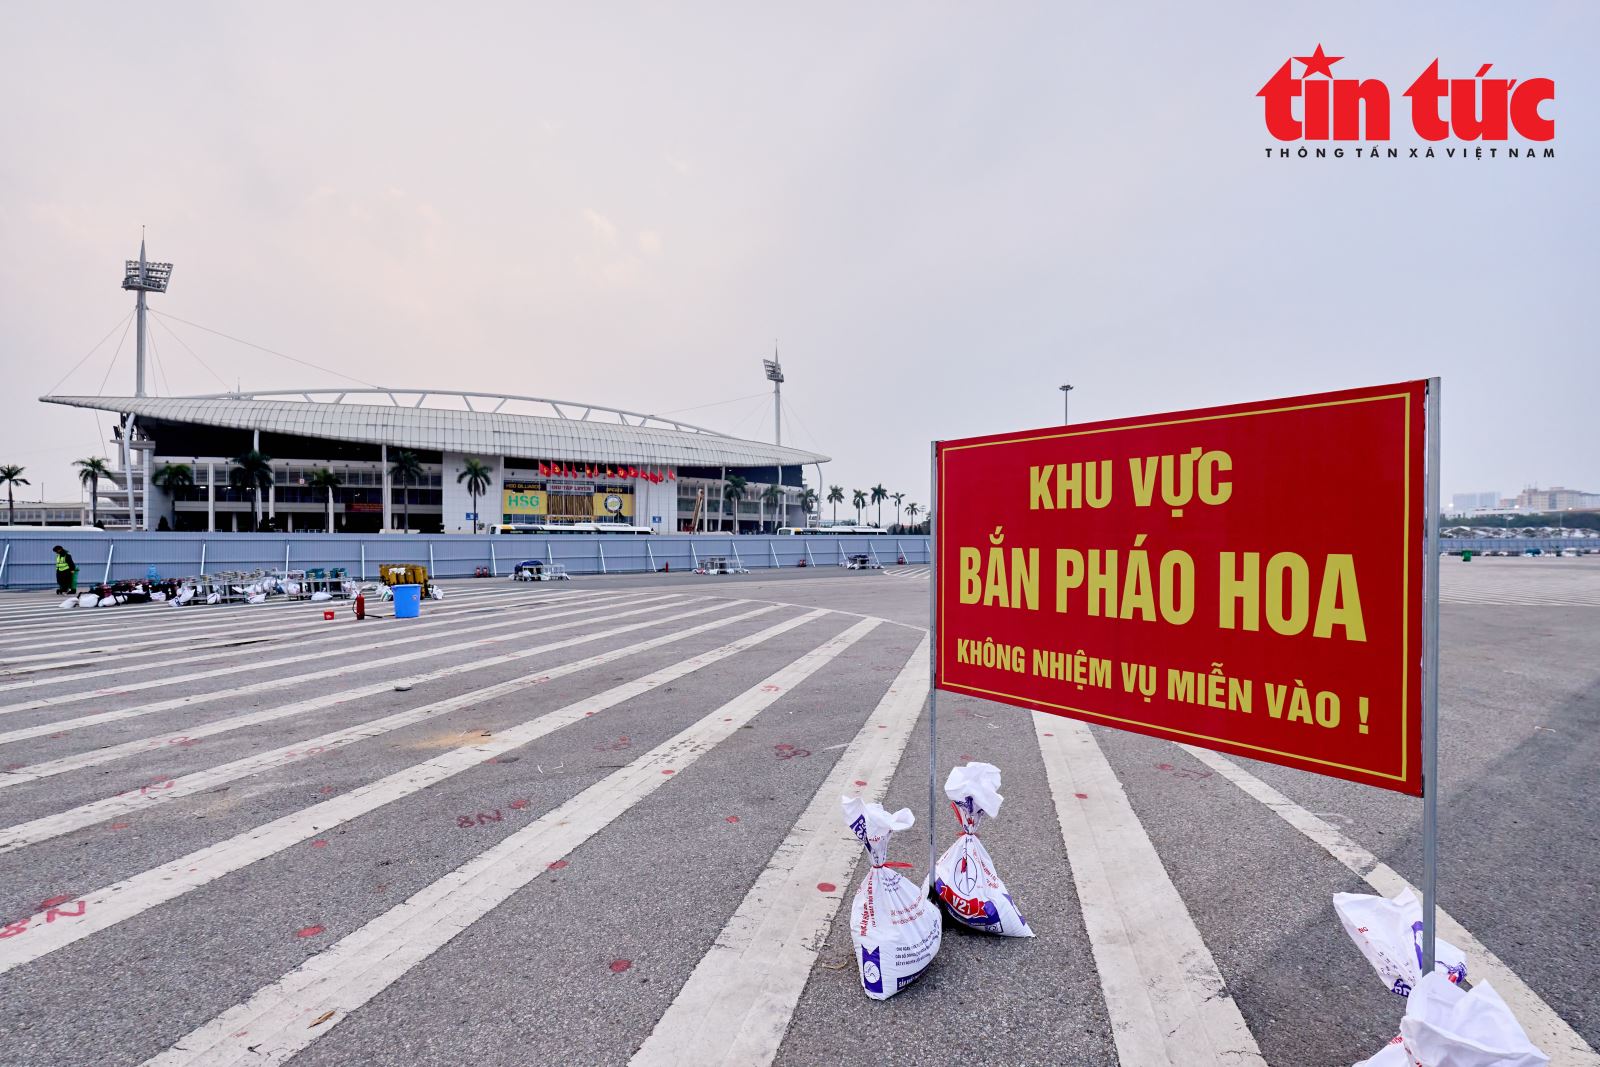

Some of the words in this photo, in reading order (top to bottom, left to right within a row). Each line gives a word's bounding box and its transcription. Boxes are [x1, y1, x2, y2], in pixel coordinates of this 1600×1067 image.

[508, 495, 540, 507] HSG
[1029, 460, 1114, 511] KHU
[1128, 447, 1234, 519] VỰC
[959, 526, 1041, 612] BẮN
[1056, 534, 1196, 626] PHÁO
[1219, 551, 1368, 643] HOA
[957, 637, 1026, 675] KHÔNG
[1032, 649, 1113, 691] NHIỆM
[1121, 662, 1158, 704] VỤ
[1167, 663, 1253, 715] MIỄN
[1264, 679, 1342, 730] VÀO
[1358, 696, 1370, 736] !
